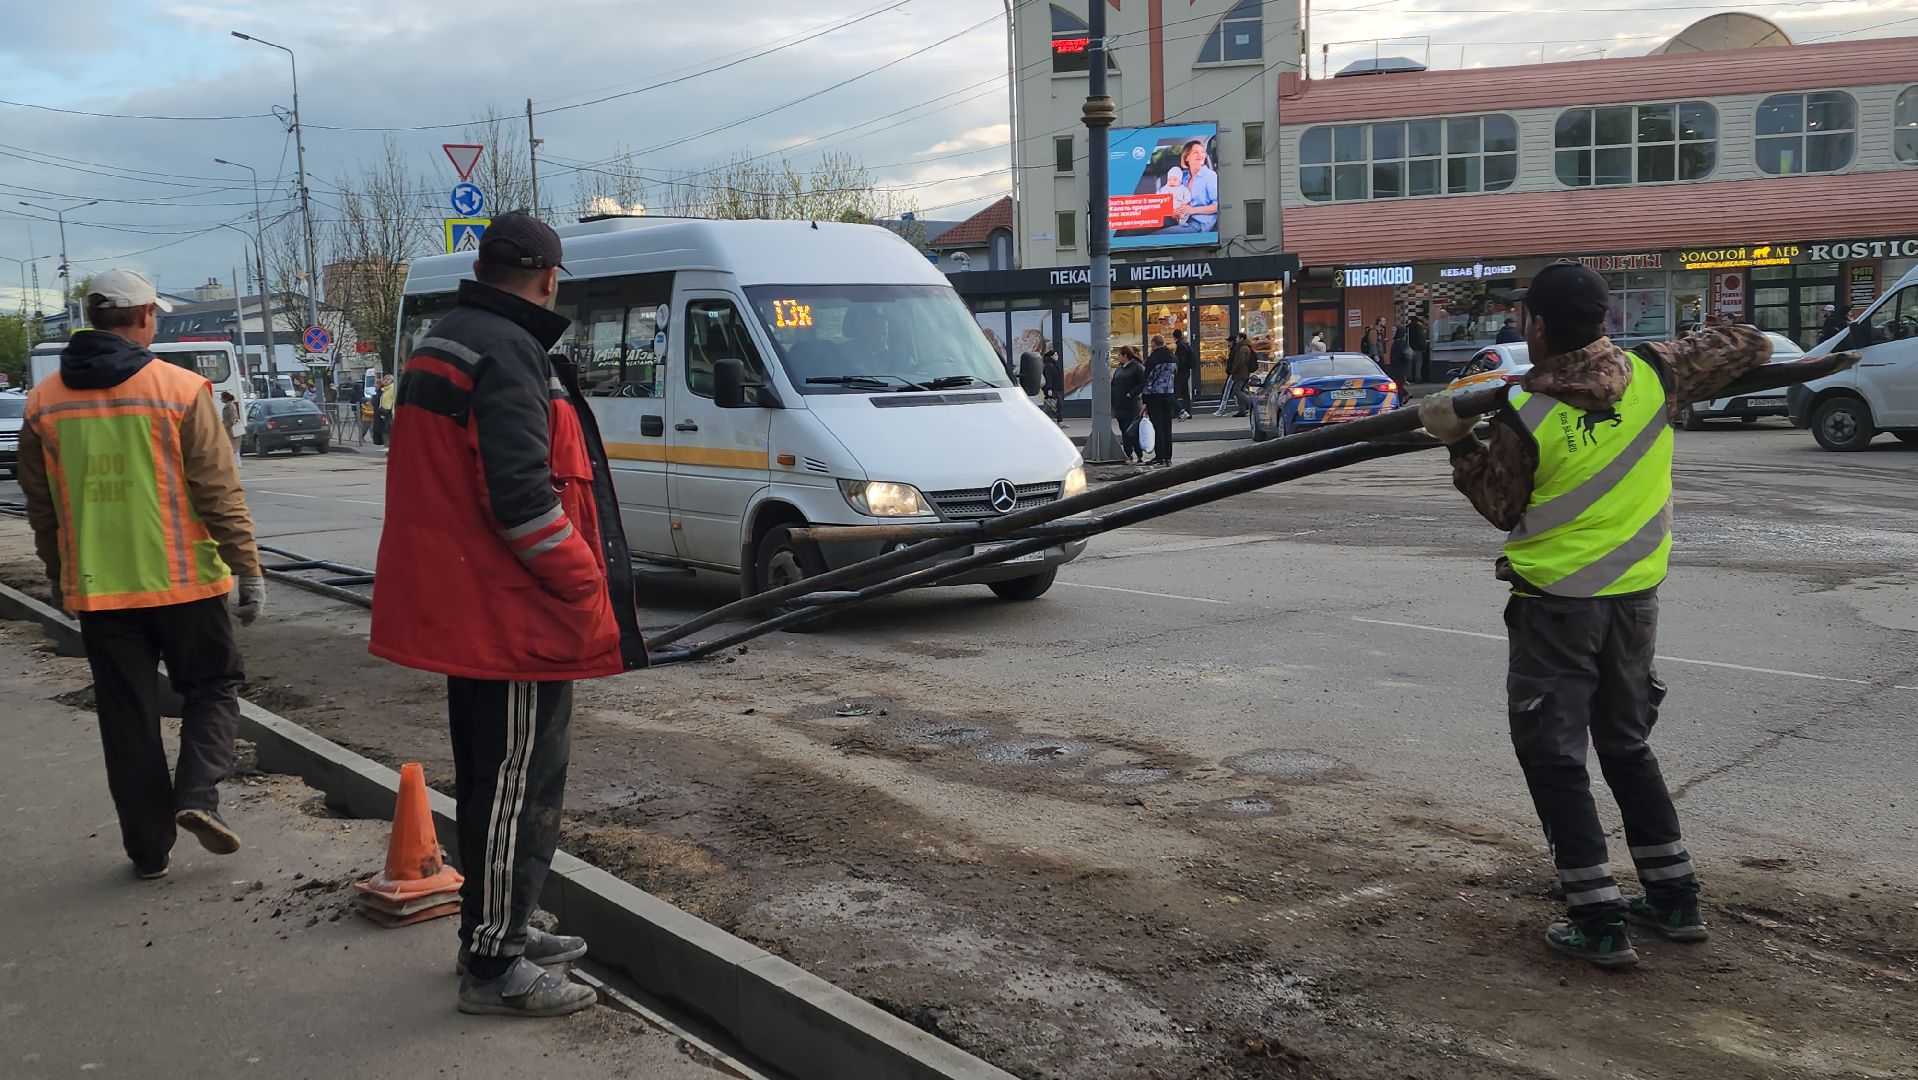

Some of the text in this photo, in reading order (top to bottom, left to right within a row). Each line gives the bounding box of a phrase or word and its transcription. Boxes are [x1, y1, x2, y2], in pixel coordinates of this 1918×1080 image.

[1680, 247, 1799, 262] ЗОЛОТОЙ ЛЕВ
[1050, 262, 1213, 285] ПЕКАЯ МЕЛЬНИЦА
[1344, 266, 1413, 287] ТАБАКОВО
[1441, 265, 1517, 277] КЕБАБ ДОНЕР
